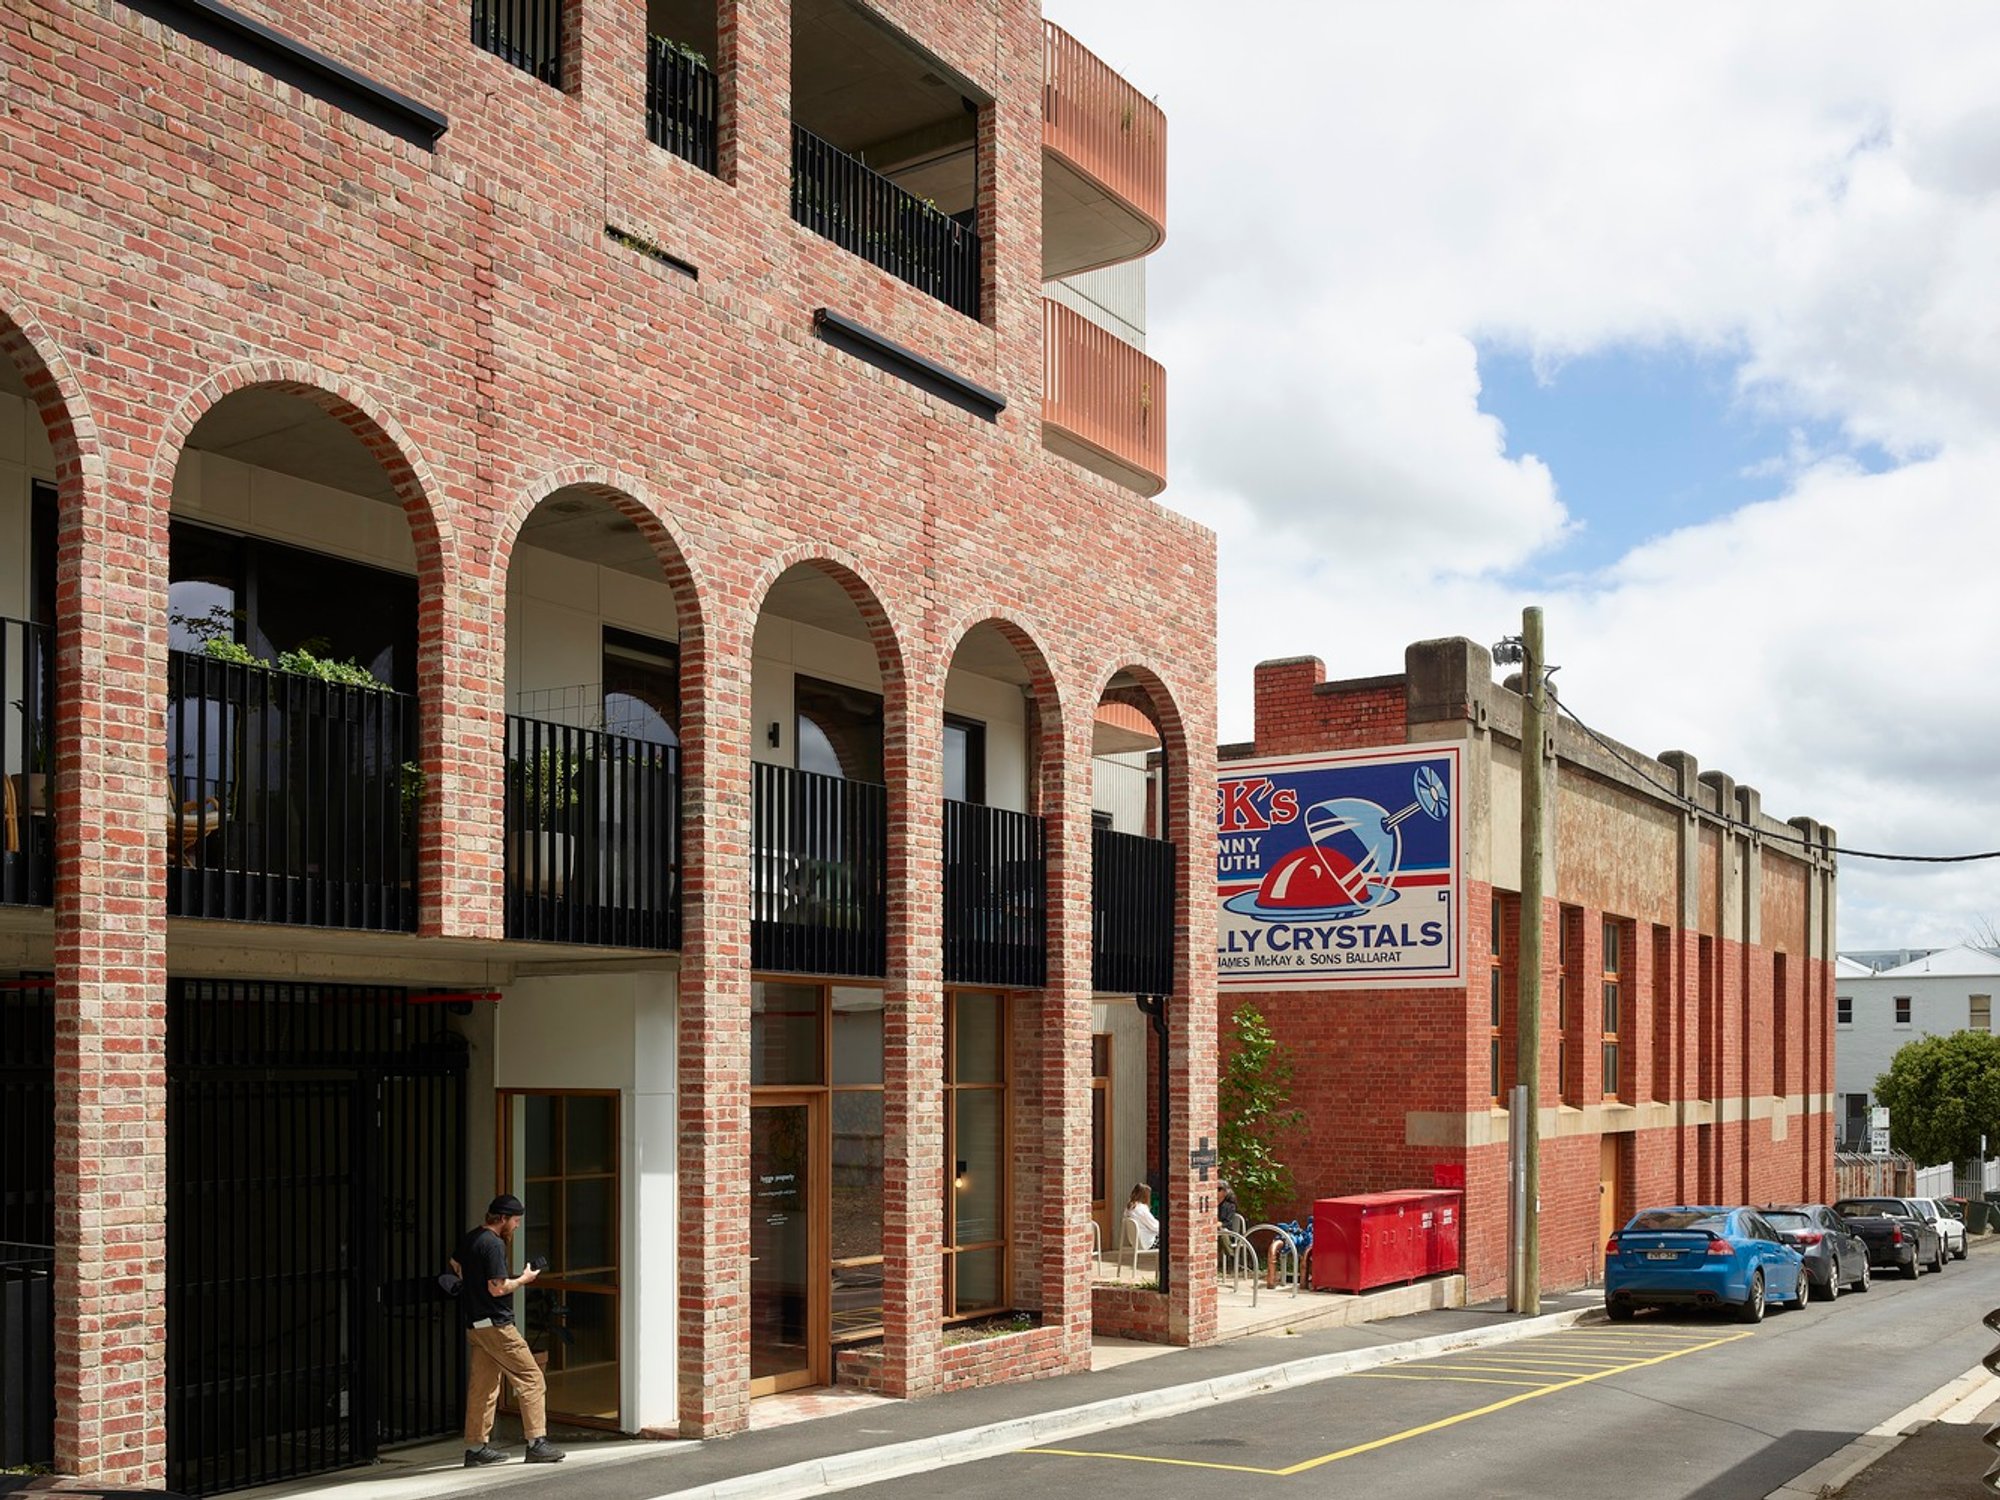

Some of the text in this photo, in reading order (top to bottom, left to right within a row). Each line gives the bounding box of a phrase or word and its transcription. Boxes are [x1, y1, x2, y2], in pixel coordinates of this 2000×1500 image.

[1219, 854, 1260, 871] UTH
[1266, 921, 1443, 952] CRYSTALS
[1254, 954, 1293, 967] McKAY
[1296, 956, 1305, 966] &
[1310, 952, 1341, 965] SONS
[1346, 951, 1402, 964] BALLARAT
